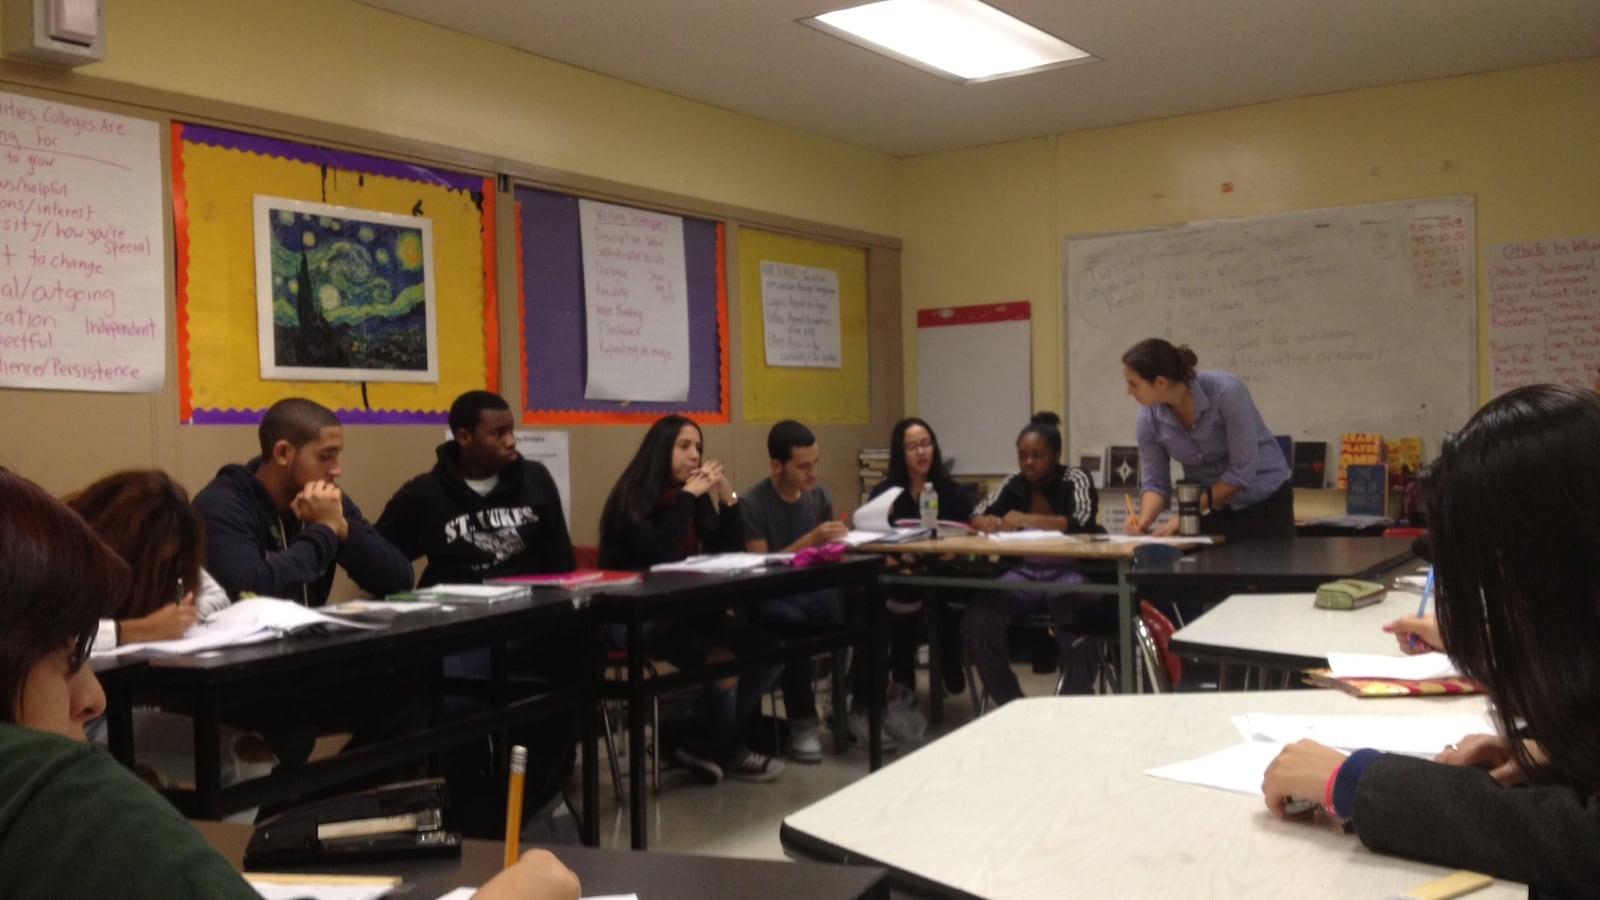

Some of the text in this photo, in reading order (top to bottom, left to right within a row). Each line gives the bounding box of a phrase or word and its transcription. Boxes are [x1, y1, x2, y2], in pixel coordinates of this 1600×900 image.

[43, 106, 95, 136] Colleges
[99, 117, 128, 136] Are
[36, 126, 59, 147] For
[5, 151, 55, 176] to grow
[28, 247, 46, 268] to
[49, 251, 104, 279] change
[0, 304, 57, 330] ation
